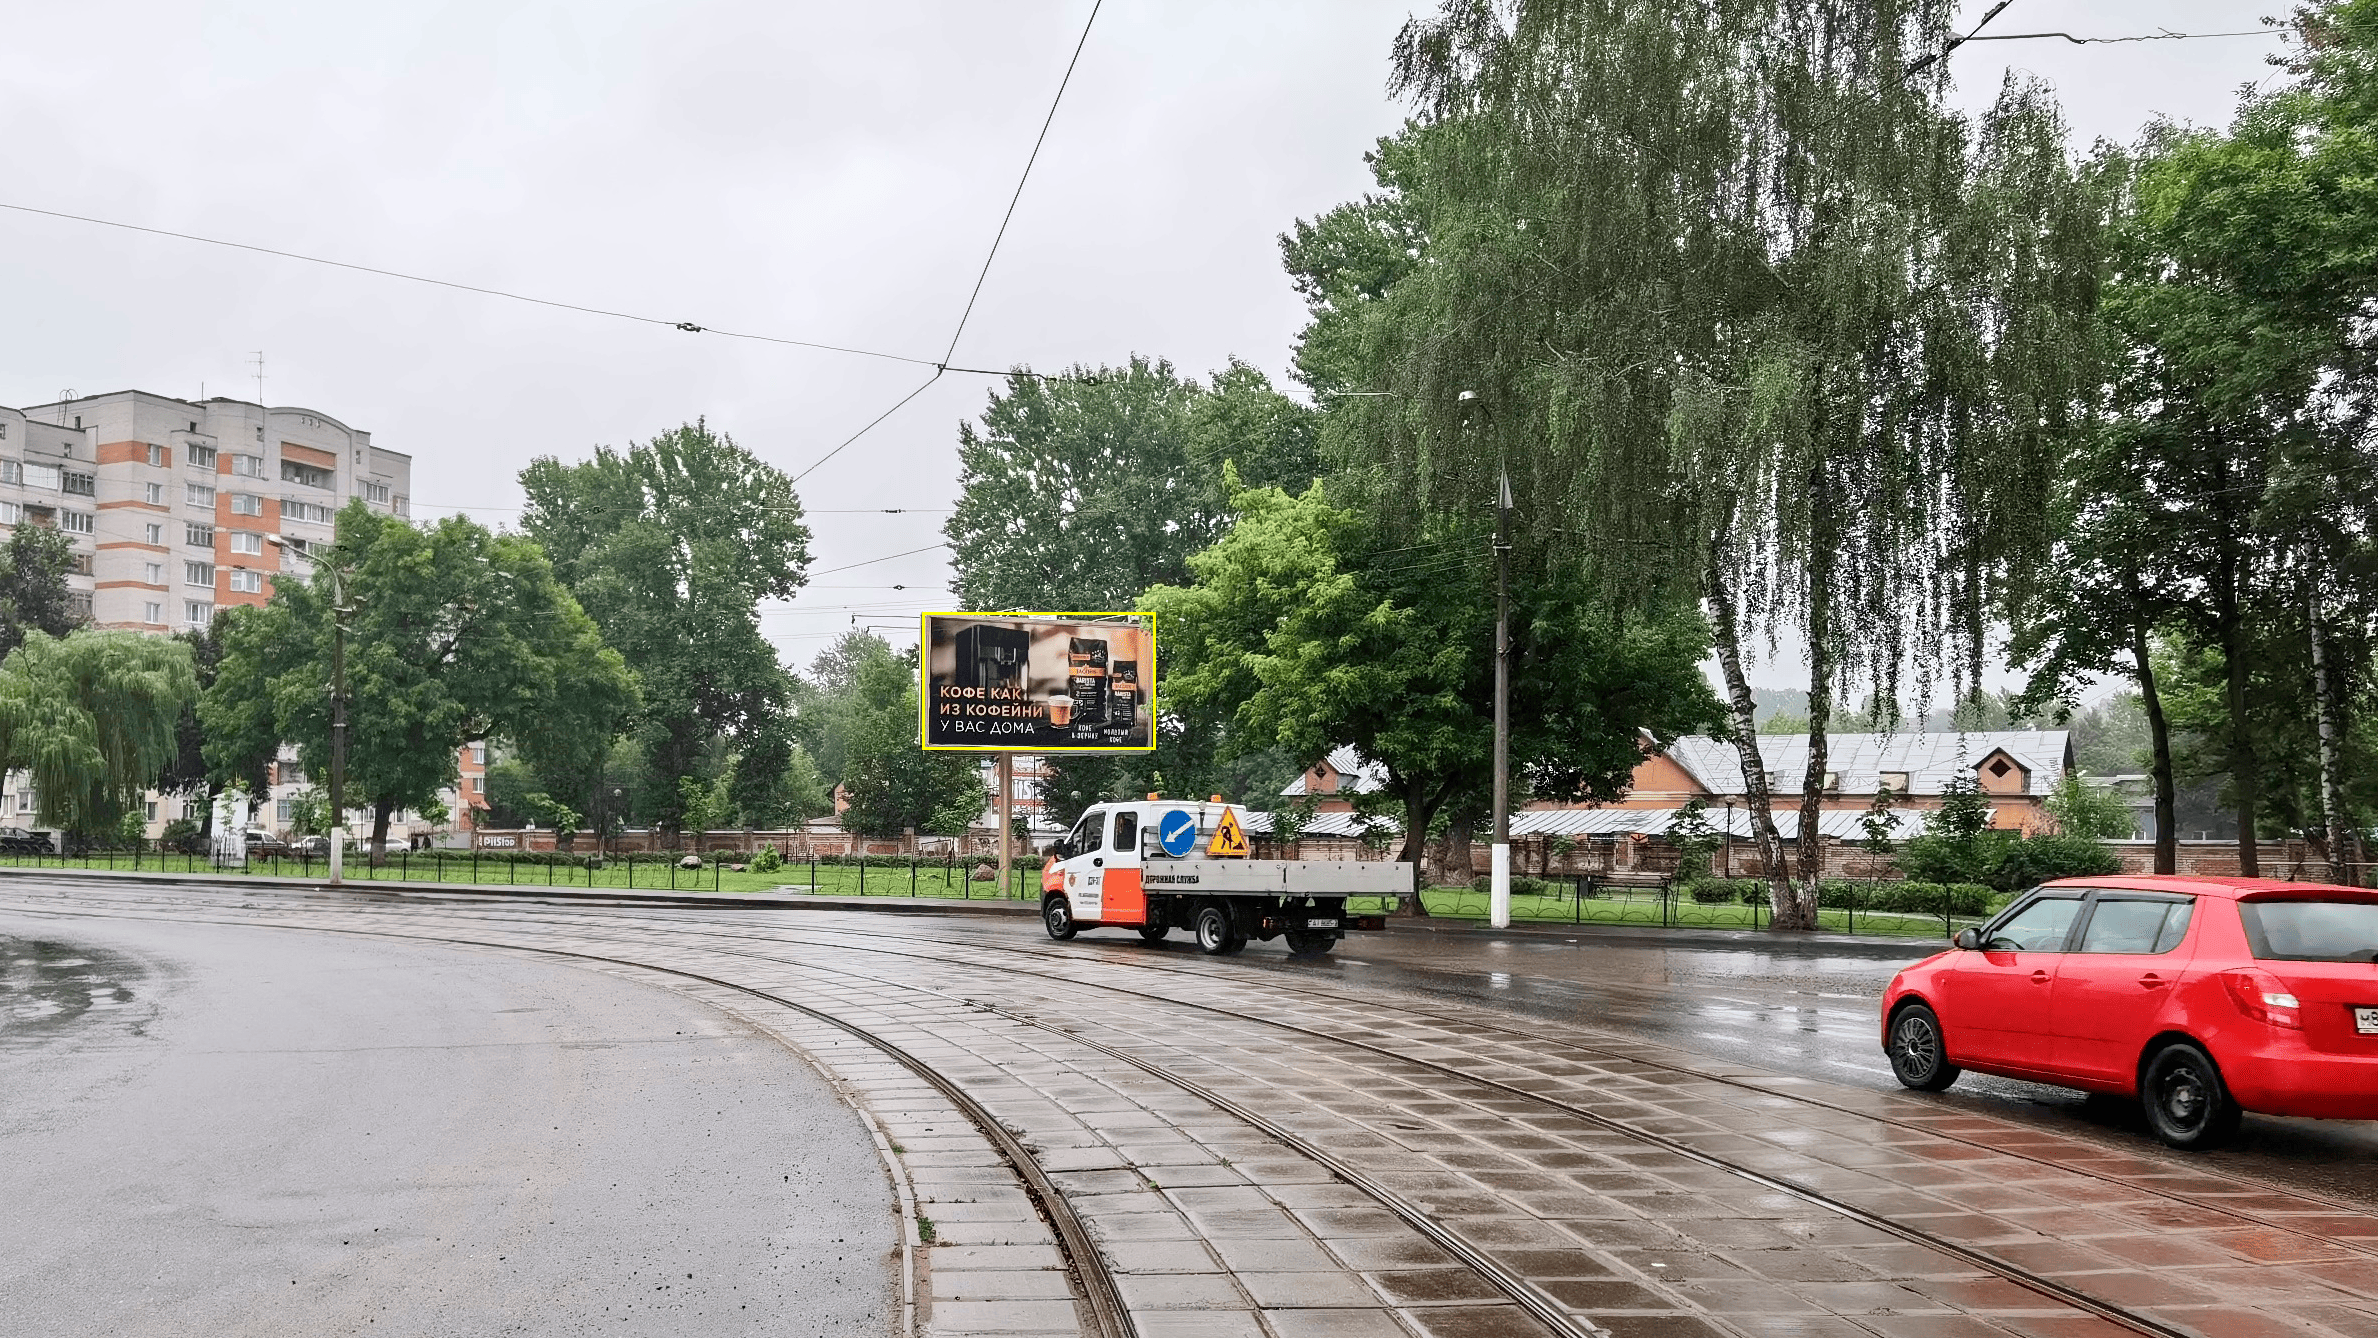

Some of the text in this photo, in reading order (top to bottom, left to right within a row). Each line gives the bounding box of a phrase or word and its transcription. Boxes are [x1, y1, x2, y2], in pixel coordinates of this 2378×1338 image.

[940, 686, 1021, 701] КОФЕ КАК
[940, 702, 1043, 718] ИЗ КОФЕЙНИ
[940, 719, 1035, 735] У ВАС ДОМА
[1078, 724, 1093, 732] КОФЕ
[1109, 736, 1123, 744] КОФЕ
[1145, 874, 1200, 884] ДОРОЖНАЯ СЛУЖБА
